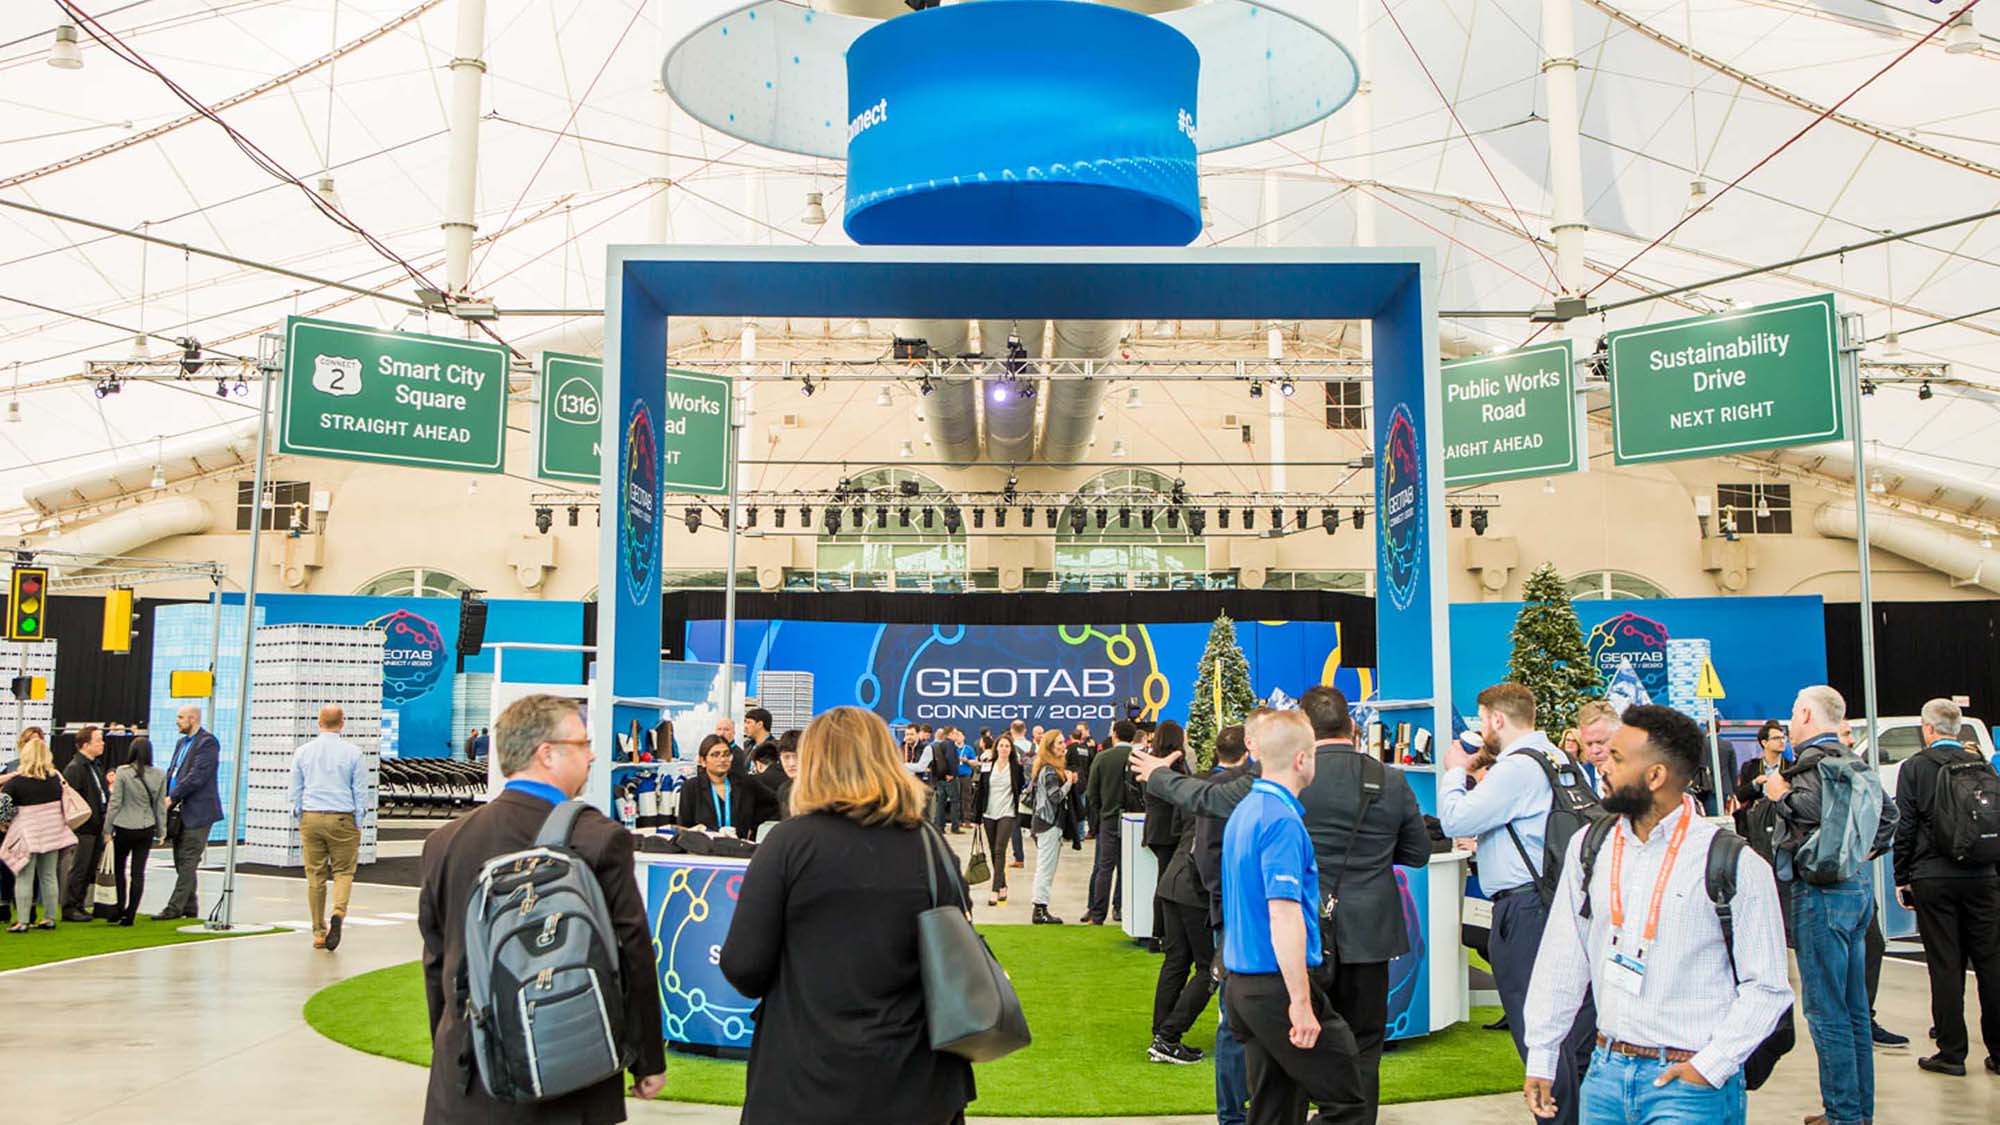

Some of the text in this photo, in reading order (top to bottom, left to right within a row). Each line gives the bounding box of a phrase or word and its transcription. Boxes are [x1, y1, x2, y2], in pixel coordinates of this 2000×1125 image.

[848, 98, 887, 144] nnect
[320, 358, 356, 368] CONNECT
[1649, 333, 1790, 371] Sustainability
[330, 368, 344, 390] 2
[378, 354, 485, 391] Smart City
[1693, 368, 1746, 392] Drive
[395, 384, 467, 410] Square
[1447, 369, 1560, 403] Public Works
[560, 393, 597, 416] 1316
[667, 392, 720, 415] Works
[1482, 397, 1526, 423] Road
[1670, 400, 1774, 429] NEXT RIGHT
[320, 413, 471, 443] STRAIGHT AHEAD
[665, 417, 686, 435] ad
[1442, 433, 1543, 460] AIGHT AHEAD
[1388, 485, 1414, 515] GEOTAB
[384, 649, 432, 660] EOTAB
[1600, 651, 1663, 662] GEOTAB
[916, 668, 1115, 697] GEOTAB
[917, 704, 1032, 719] CONNECT
[1050, 704, 1115, 719] 2020
